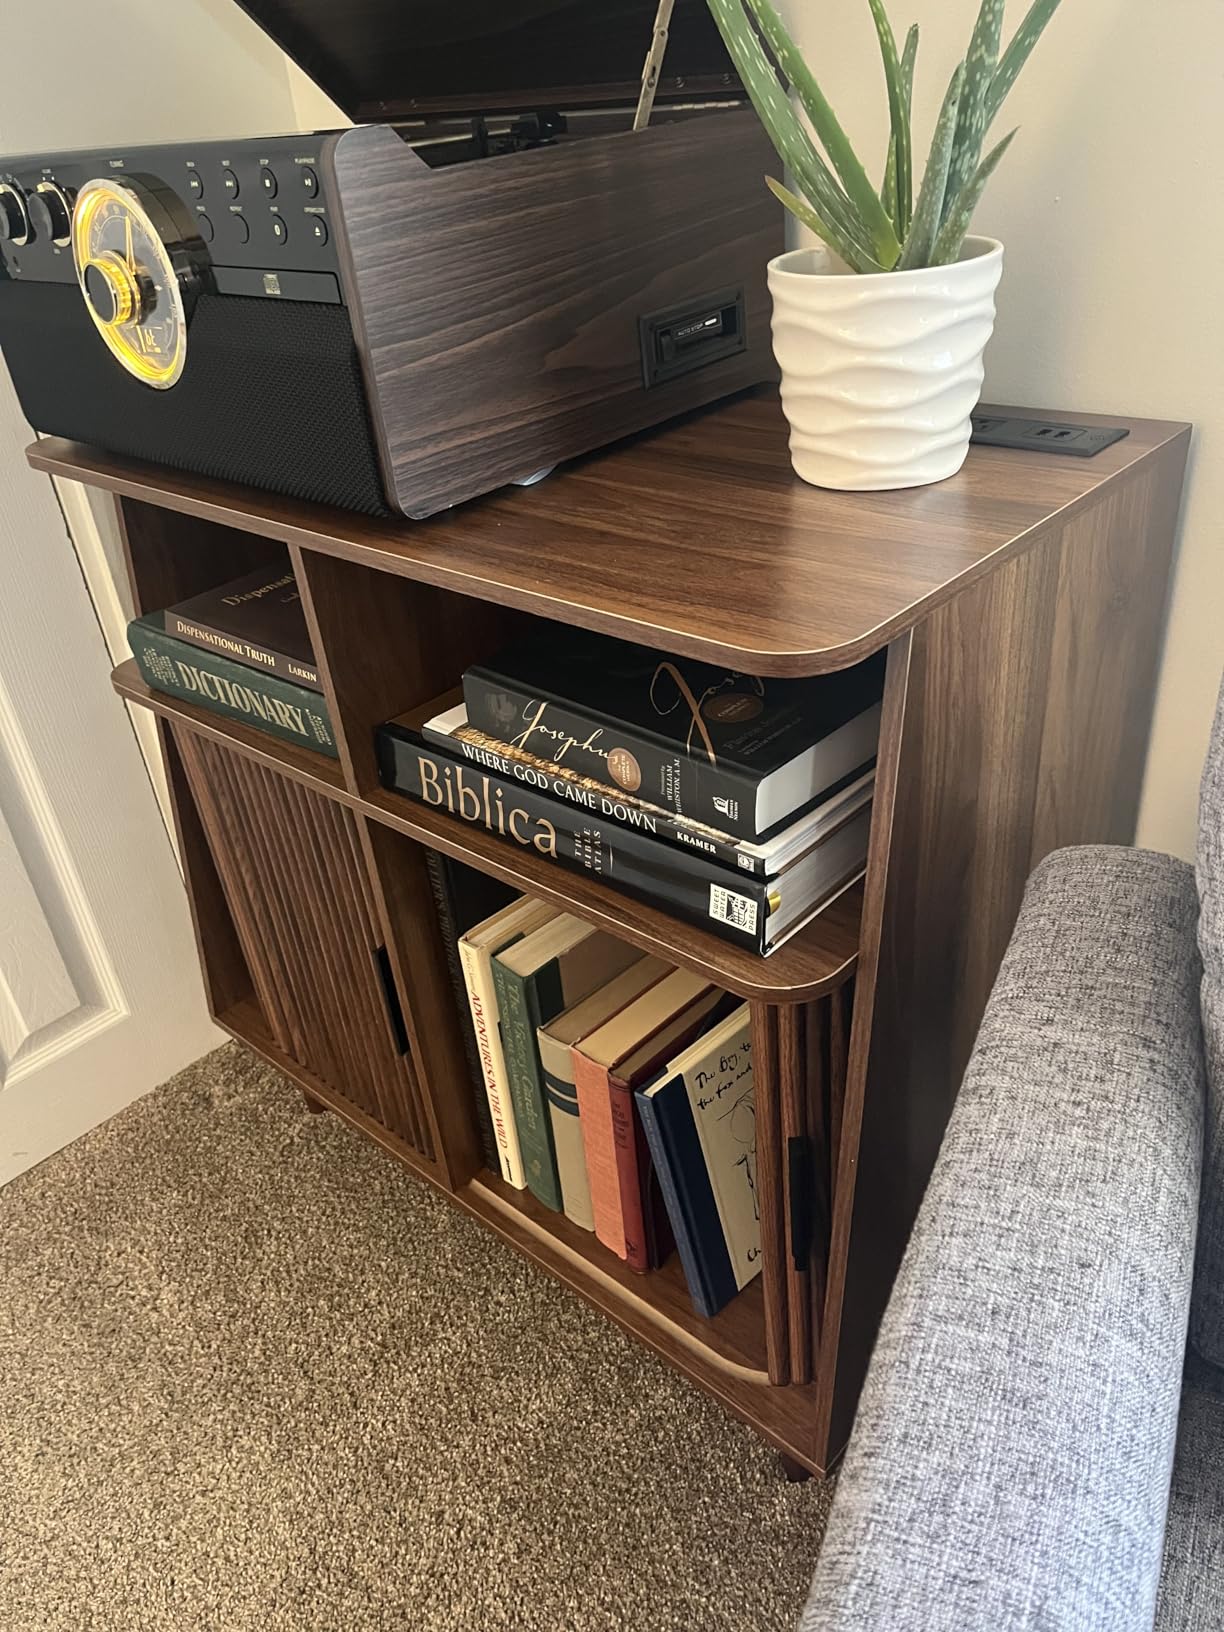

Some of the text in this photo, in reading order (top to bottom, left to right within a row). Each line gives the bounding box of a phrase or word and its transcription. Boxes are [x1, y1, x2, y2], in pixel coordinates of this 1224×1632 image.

[177, 621, 317, 683] DISPENSATIONAL TRUTH LARKIN
[175, 660, 309, 737] DICTIONARY
[418, 756, 558, 859] Biblica
[461, 743, 657, 834] WHERE GOD CAME DOWN
[674, 777, 682, 813] WHISTON
[574, 831, 582, 857] THE
[583, 828, 592, 869] BIBLE
[593, 830, 602, 874] ATLAS
[676, 831, 717, 854] KRAMER
[748, 903, 756, 932] PRESS
[471, 991, 508, 1150] ADVENTURES IN THE WILD
[694, 1071, 716, 1089] The
[697, 1095, 715, 1110] the
[715, 1081, 734, 1099] fox
